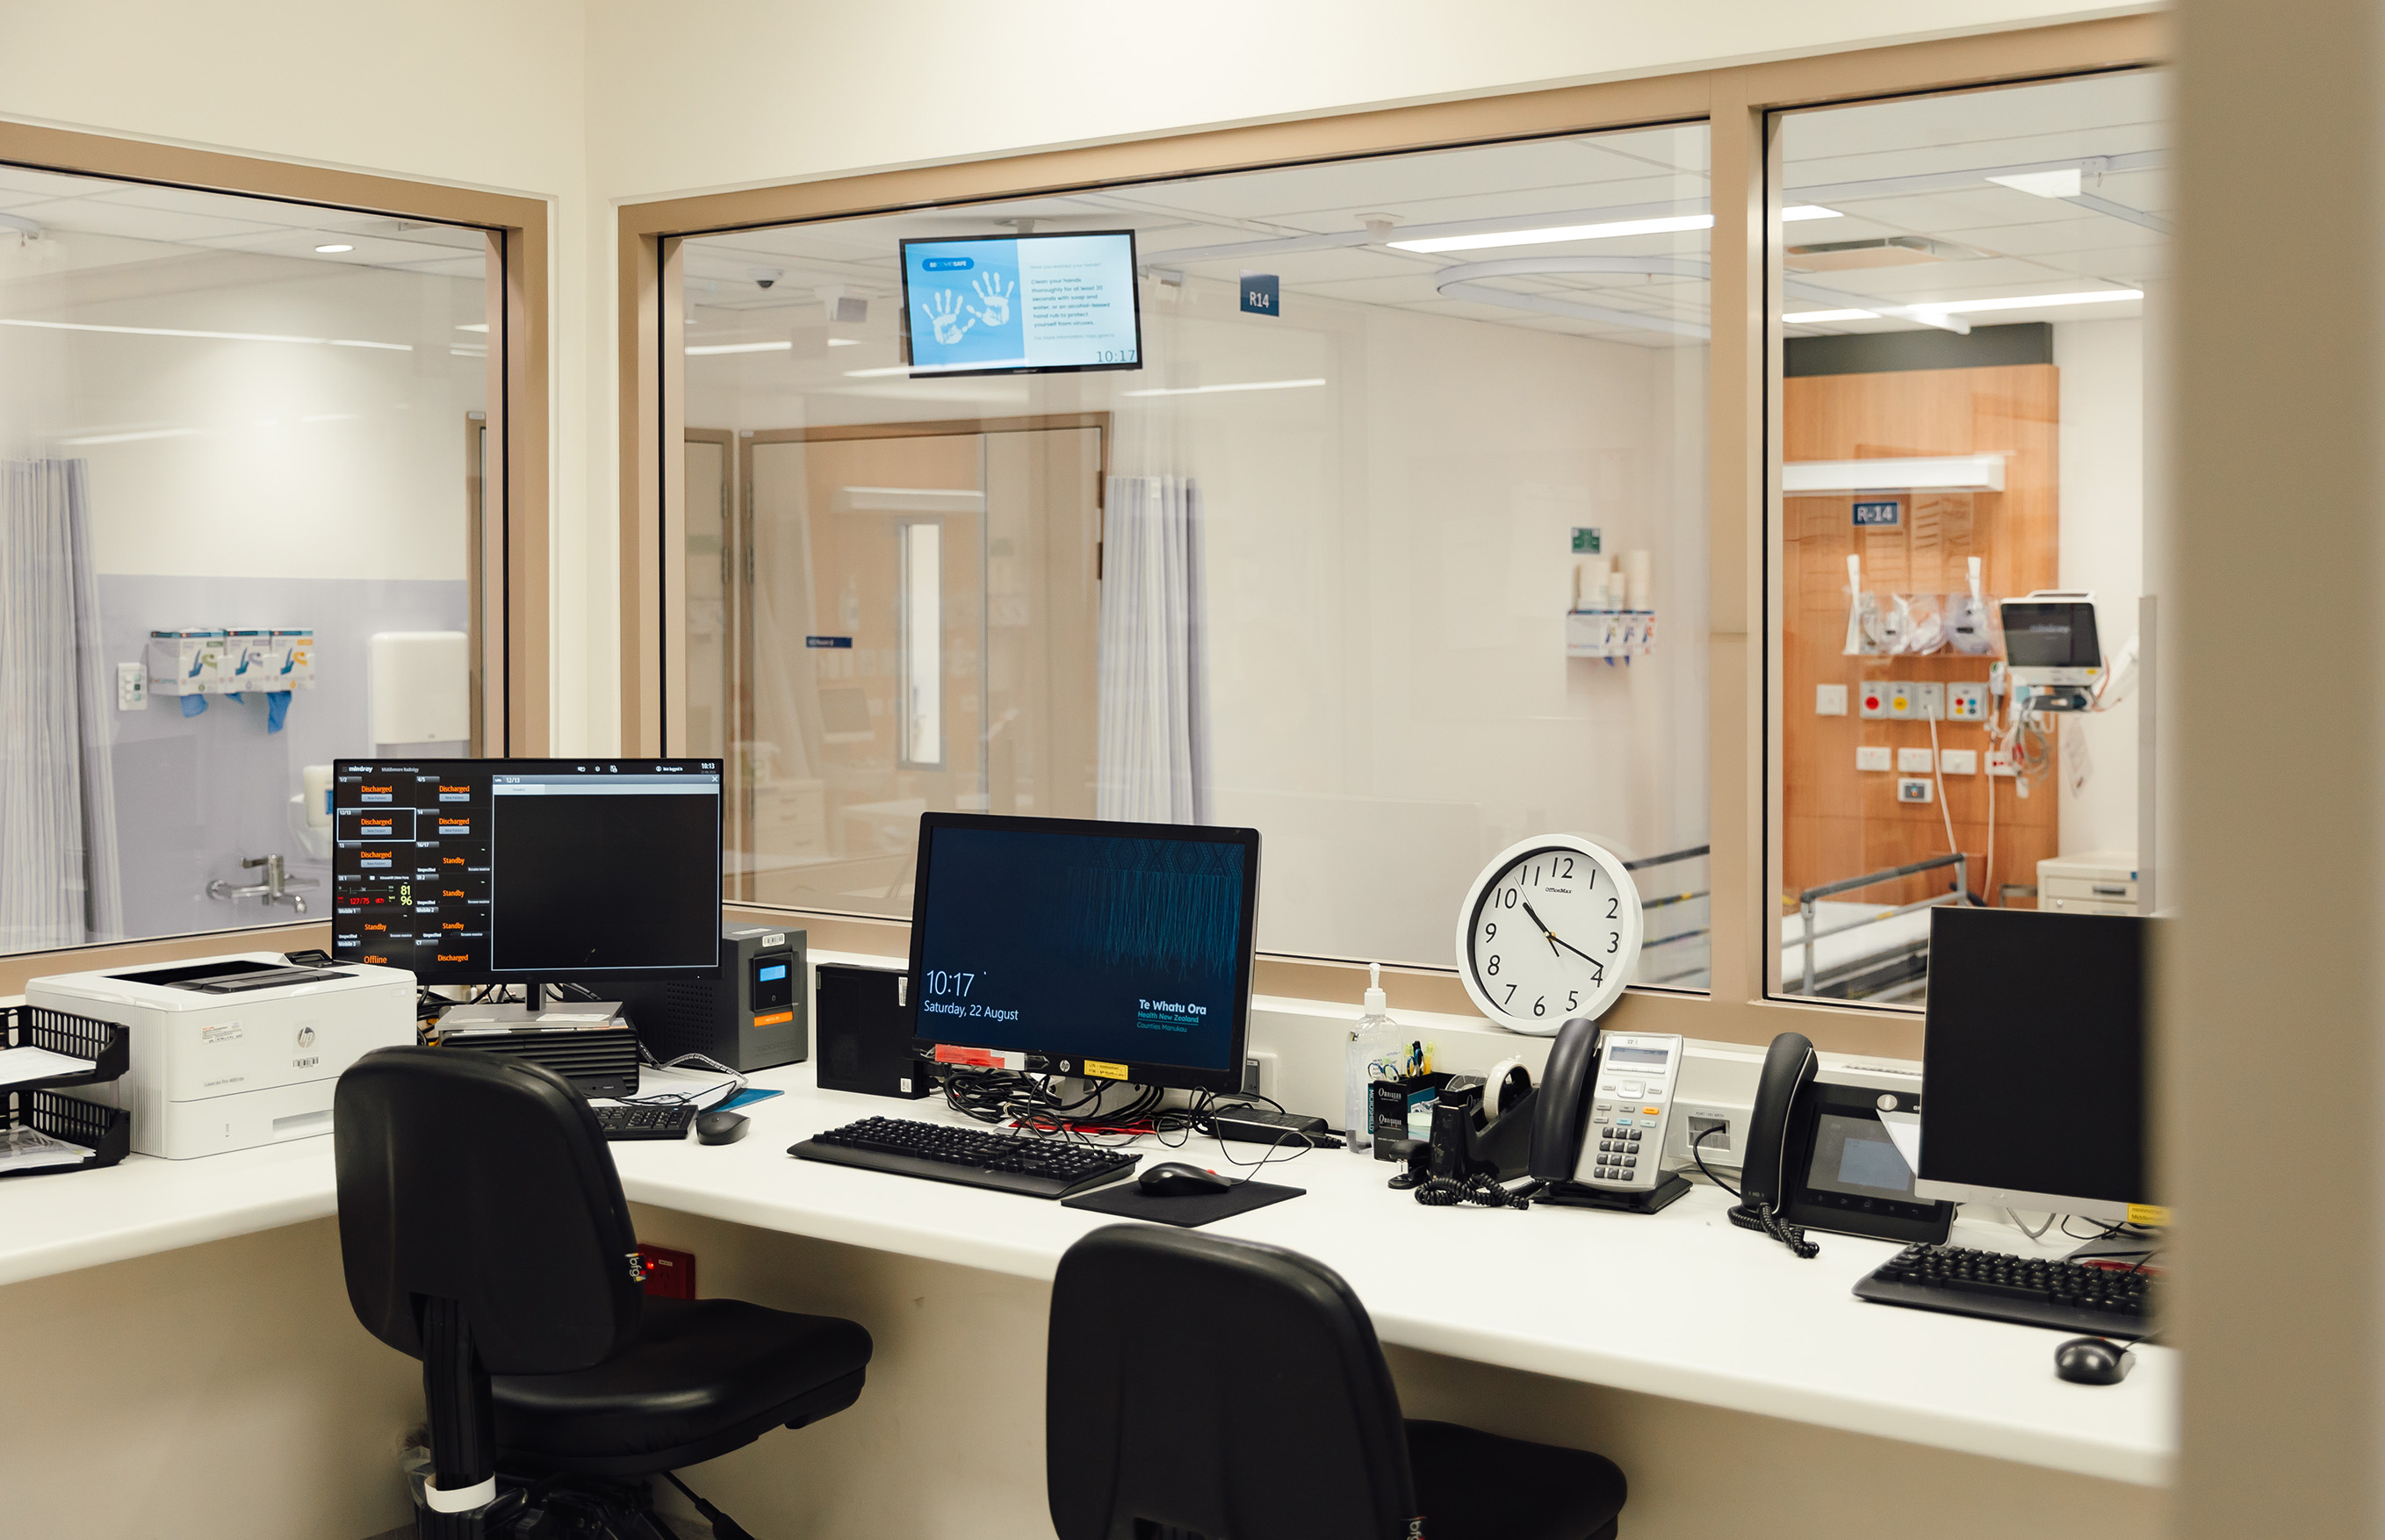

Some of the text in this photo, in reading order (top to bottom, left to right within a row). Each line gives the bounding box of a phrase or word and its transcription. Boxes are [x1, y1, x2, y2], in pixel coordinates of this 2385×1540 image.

[1249, 291, 1270, 309] R14
[1096, 350, 1135, 363] 10:17
[1857, 506, 1892, 522] R-14
[361, 785, 393, 794] Discharged
[439, 785, 470, 794] Discharged
[361, 851, 393, 860] Discharged
[443, 857, 465, 866] Standby
[1521, 865, 1540, 887] 11
[1552, 857, 1574, 879] 12
[1589, 869, 1596, 890] 1
[400, 885, 411, 896] 81
[443, 889, 465, 898] Standby
[1495, 888, 1517, 909] 10
[400, 896, 413, 906] 96
[1605, 897, 1619, 919] 2
[364, 924, 387, 932] Standby
[443, 922, 465, 931] Standby
[1485, 923, 1497, 943] 9
[1607, 932, 1620, 954] 3
[364, 955, 387, 964] Offline
[1488, 954, 1501, 976] 8
[927, 969, 975, 997] 10:17
[1590, 966, 1603, 988] 4
[1505, 983, 1517, 1005] 7
[1566, 990, 1579, 1011] 5
[924, 1000, 1019, 1022] Saturday, 22 August
[1139, 999, 1207, 1015] Te Whatu Ora
[1533, 996, 1546, 1017] 6
[297, 1026, 316, 1048] hp
[1162, 1024, 1187, 1033] Manukau
[1059, 1060, 1070, 1073] hp
[630, 1257, 642, 1277] bfg
